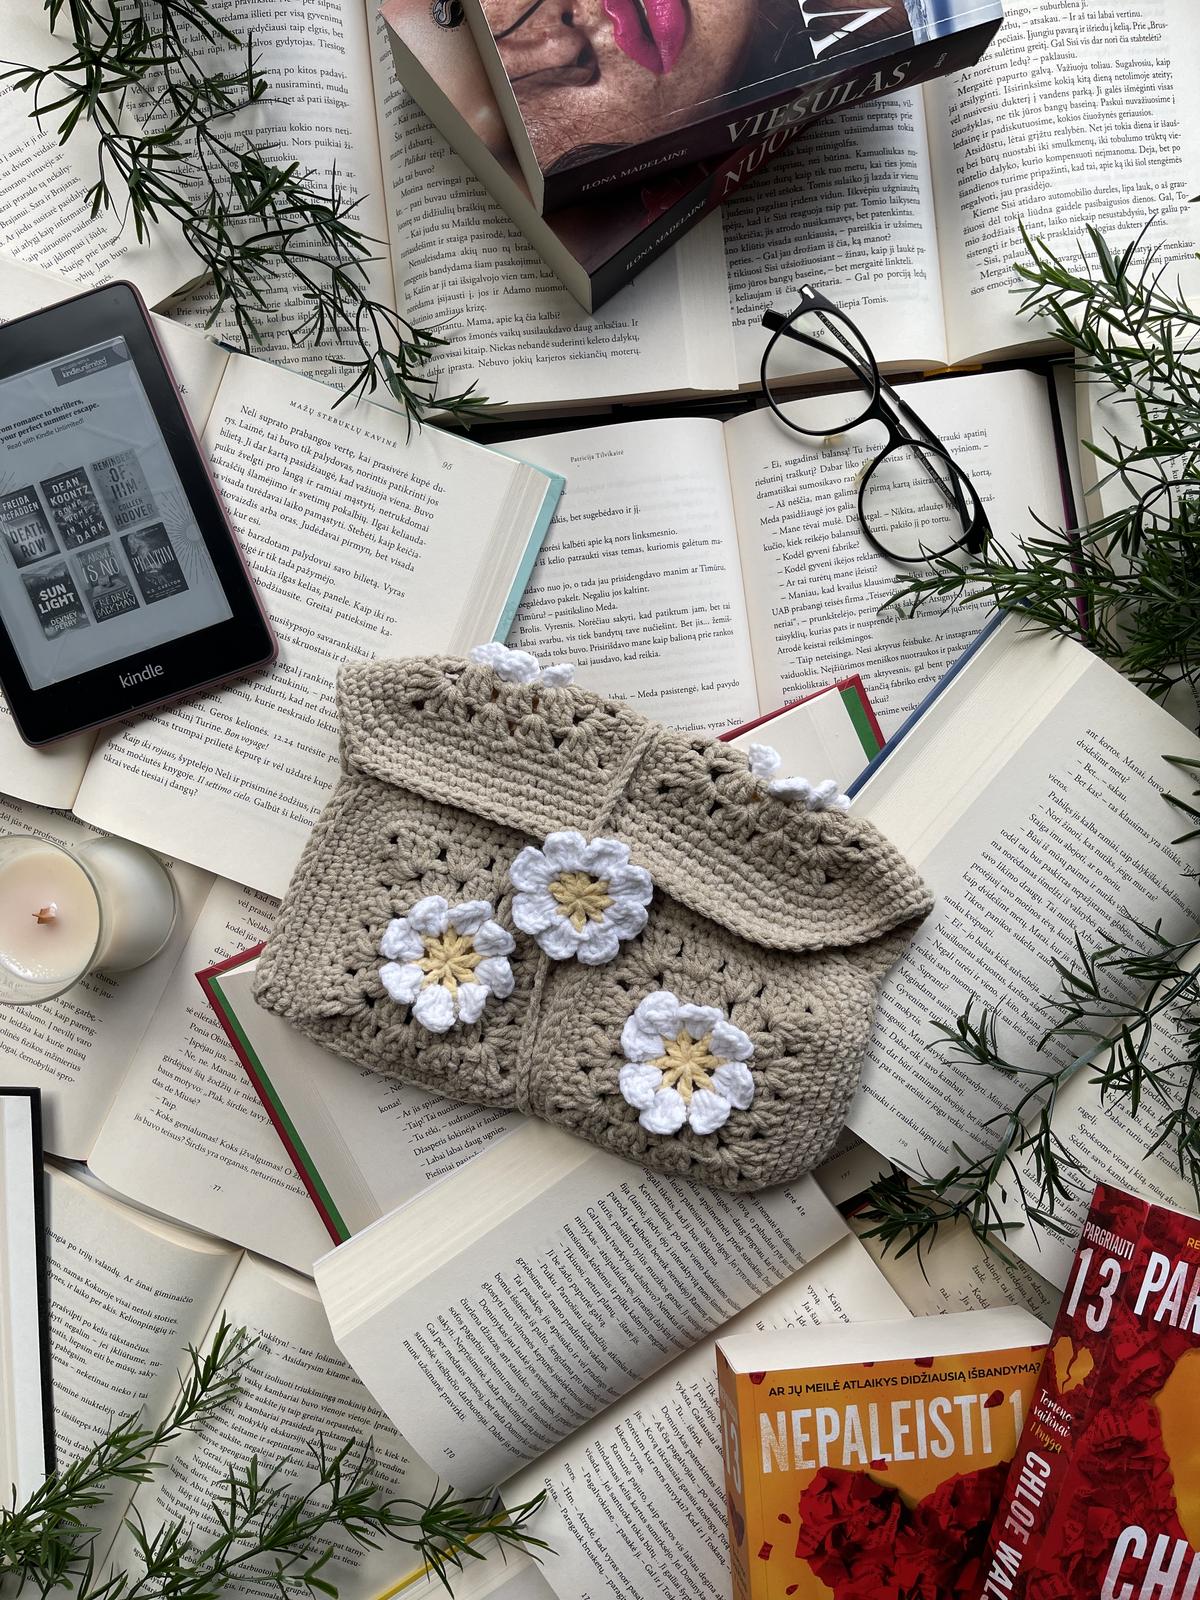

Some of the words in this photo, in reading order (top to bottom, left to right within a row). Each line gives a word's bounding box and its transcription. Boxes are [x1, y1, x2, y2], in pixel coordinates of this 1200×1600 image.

[957, 77, 994, 97] Mergaitė
[996, 71, 1028, 87] papurto
[1055, 62, 1089, 74] Važiuoju
[1090, 60, 1113, 70] toliau.
[1155, 57, 1171, 69] kaip
[724, 61, 912, 144] VIESULAS
[581, 174, 618, 192] ILONA
[620, 148, 689, 179] MADELAINE
[972, 205, 999, 219] Kieme
[1000, 199, 1016, 210] Sisi
[1017, 194, 1047, 206] atidaro
[1047, 187, 1093, 201] automobilio
[1160, 180, 1169, 190] aš
[625, 245, 653, 270] ILONA
[654, 198, 708, 246] MADELAINE
[812, 328, 824, 338] 156
[0, 432, 16, 444] your
[18, 422, 42, 438] perfect
[43, 413, 72, 426] summer
[74, 402, 100, 416] escape.
[14, 412, 44, 428] romance
[44, 410, 52, 418] to
[52, 400, 84, 415] thrillers,
[289, 400, 315, 416] MAŽŲ
[316, 411, 362, 436] STEBUKLŲ
[364, 430, 397, 449] KAVINĖ
[7, 440, 22, 451] Read
[224, 416, 237, 426] rys.
[238, 419, 265, 438] Laimė,
[266, 431, 279, 442] tai
[278, 434, 300, 450] buvo
[300, 445, 313, 456] tik
[312, 451, 355, 474] palydovas,
[355, 468, 388, 486] norintis
[387, 481, 427, 502] patikrinti
[426, 495, 440, 506] jos
[240, 404, 258, 418] Neli
[258, 414, 289, 431] suprato
[289, 426, 332, 448] prabangos
[333, 443, 356, 459] vertę,
[357, 451, 372, 464] kai
[371, 460, 409, 479] prasivėrė
[410, 472, 431, 488] kupė
[432, 482, 446, 493] du-
[109, 464, 126, 482] OF
[442, 460, 454, 471] 95
[50, 485, 92, 506] KOONTZ
[52, 477, 79, 494] DEAN
[2, 495, 30, 510] FREIDA
[114, 504, 154, 525] HOOVER
[759, 514, 780, 526] Meda
[781, 506, 824, 524] pasidžiaugė
[824, 505, 836, 515] jos
[837, 501, 857, 514] galia.
[10, 522, 46, 544] DEATH
[67, 527, 75, 535] IN
[78, 515, 94, 528] THE
[76, 522, 105, 544] DARK
[20, 538, 46, 558] ROW
[82, 565, 98, 583] IS
[100, 556, 120, 576] NO
[38, 592, 75, 614] LIGHT
[39, 583, 67, 600] SUN
[519, 624, 542, 635] Brolis.
[543, 621, 576, 633] Vyresnis.
[577, 617, 611, 627] Norėčiau
[612, 613, 636, 624] sakyti,
[638, 609, 653, 620] kad
[655, 607, 689, 620] patiktum
[691, 605, 708, 615] jam,
[709, 602, 721, 612] bet
[776, 643, 802, 655] Atrodė
[802, 639, 827, 651] keistai
[828, 633, 874, 647] reikšmingos.
[118, 663, 165, 689] kindle
[1076, 739, 1109, 768] dvidešimt
[1108, 765, 1131, 784] metų?
[1028, 813, 1050, 834] Staiga
[1048, 829, 1064, 845] imu
[1062, 842, 1088, 865] abejoti,
[1087, 862, 1096, 870] ar
[1094, 867, 1104, 876] to
[1102, 874, 1121, 892] noriu.
[425, 1151, 446, 1166] Labai
[445, 1143, 464, 1157] labai
[464, 1137, 483, 1149] daug
[481, 1124, 507, 1141] ugnies.
[1083, 1222, 1135, 1260] PARGRIAUTI
[1067, 1247, 1122, 1333] 13
[402, 1339, 421, 1361] munė
[417, 1359, 445, 1393] užsimanė
[439, 1391, 467, 1422] pravirkti.
[768, 1386, 786, 1397] AR
[788, 1384, 802, 1396] JŲ
[805, 1380, 840, 1394] MEILĖ
[842, 1376, 898, 1391] ATLAIKYS
[900, 1369, 966, 1386] DIDŽIAUSIĄ
[968, 1362, 1041, 1379] IŠBANDYMĄ?
[1034, 1405, 1071, 1438] vaikinai
[1040, 1388, 1074, 1422] Tomeno
[759, 1392, 993, 1474] NEPALEISTI
[1035, 1423, 1062, 1455] knyga
[443, 1447, 455, 1459] 170
[614, 1424, 632, 1452] kikeno
[629, 1451, 645, 1476] vyras.
[1005, 1451, 1050, 1545] CHLOE
[980, 1540, 1022, 1600] WAL
